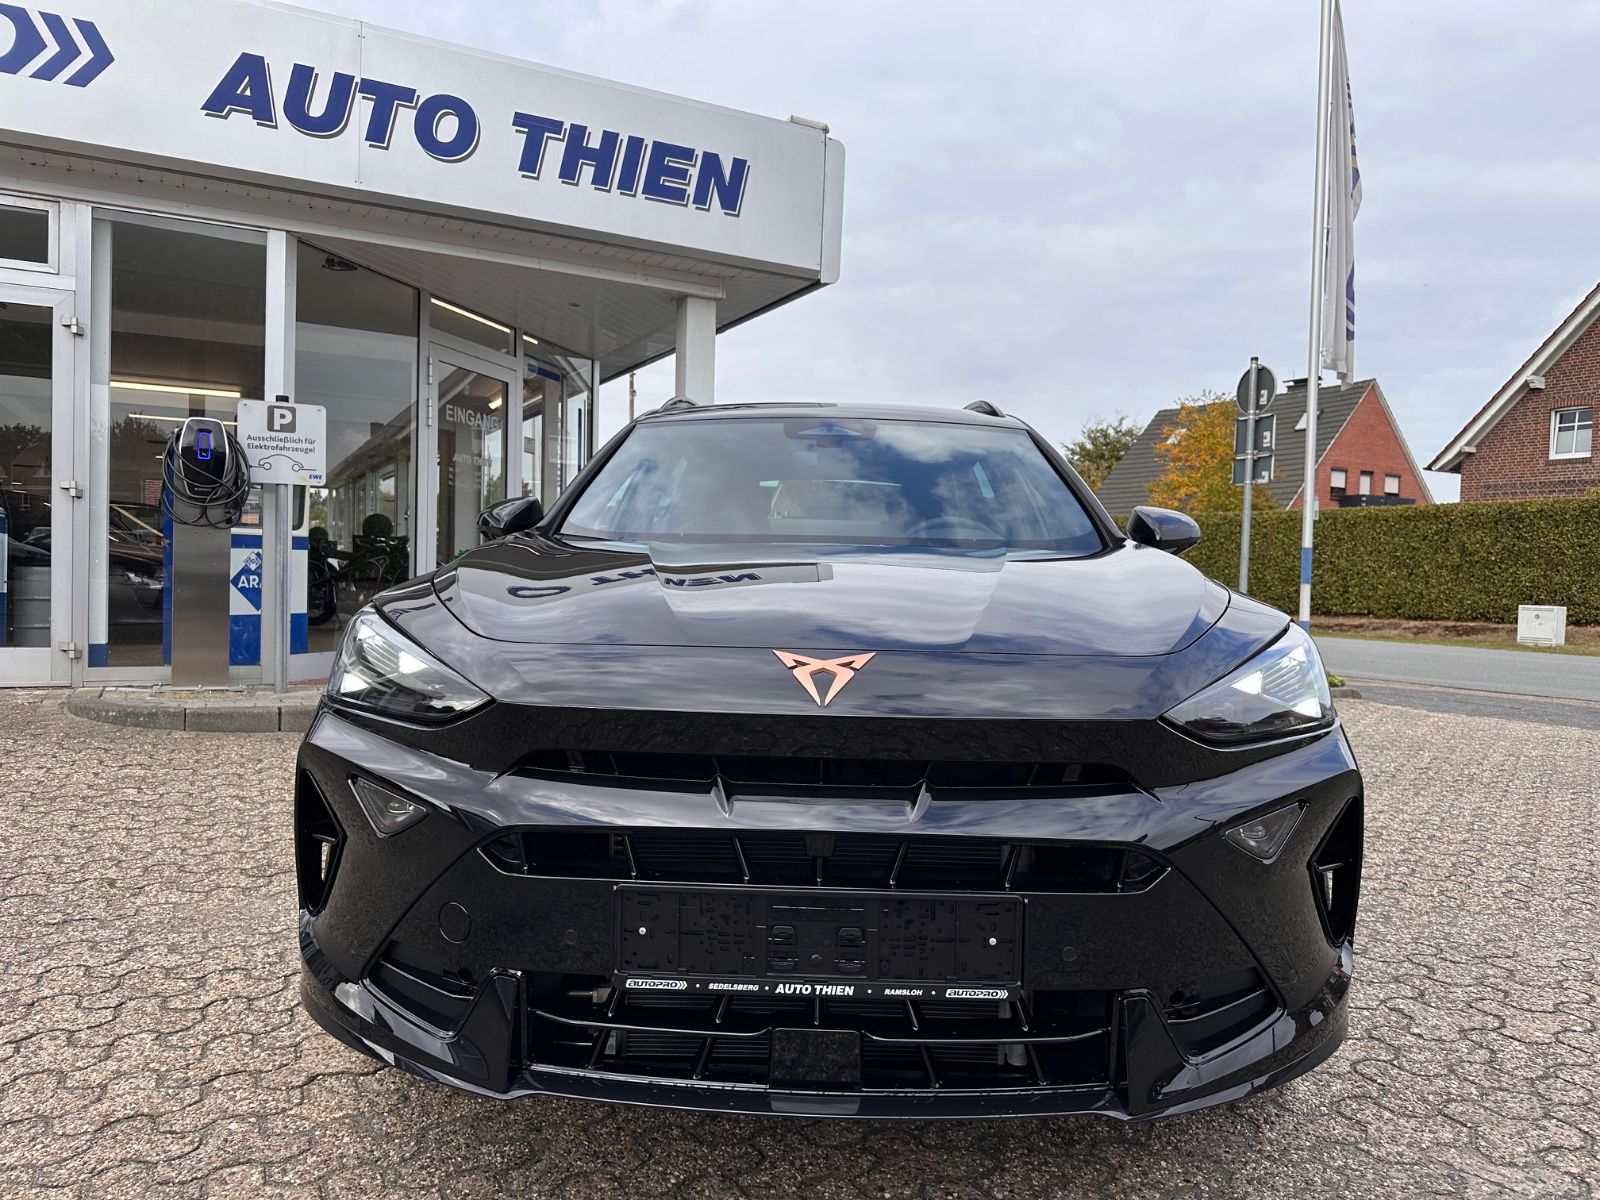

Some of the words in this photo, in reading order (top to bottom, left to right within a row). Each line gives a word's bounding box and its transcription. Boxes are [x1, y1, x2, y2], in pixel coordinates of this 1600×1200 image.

[201, 52, 480, 163] AUTO
[512, 110, 750, 217] THIEN
[273, 407, 293, 431] P
[445, 404, 500, 432] EINGANG
[246, 434, 303, 445] Ausschließlich
[304, 437, 317, 445] für
[246, 443, 316, 454] Elektrofahrzeuge!
[237, 575, 262, 589] AR
[708, 982, 759, 991] SEDELSBERG
[775, 983, 811, 994] AUTO
[814, 985, 855, 996] THIEN
[884, 988, 923, 996] RAMSLOH
